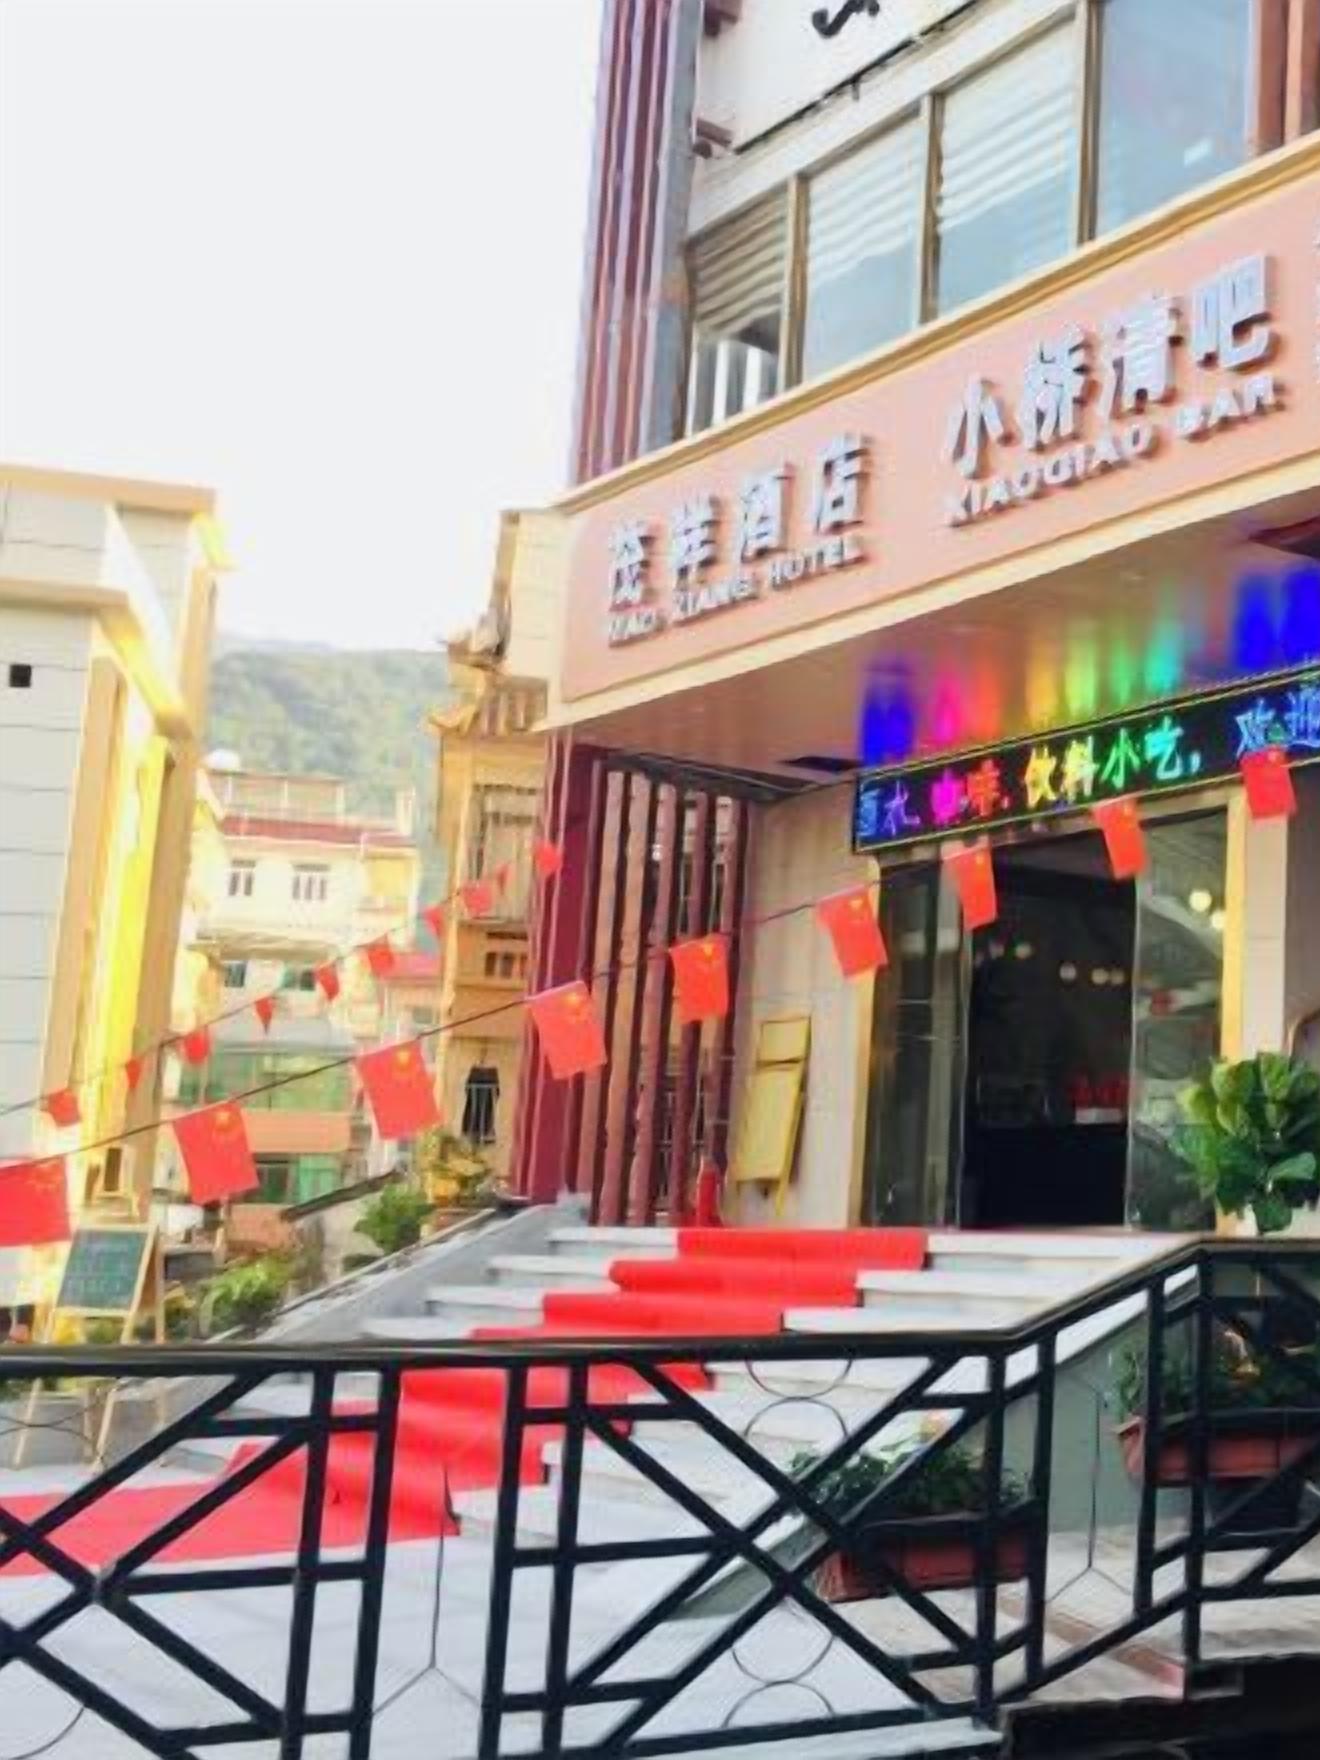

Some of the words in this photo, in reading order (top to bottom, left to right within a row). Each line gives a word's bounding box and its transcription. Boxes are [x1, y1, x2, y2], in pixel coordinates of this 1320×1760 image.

[942, 252, 1272, 480] 小桥清吧
[942, 422, 1153, 527] XIAOQIAO
[1174, 373, 1278, 440] BAR
[770, 537, 864, 588] HOTEL
